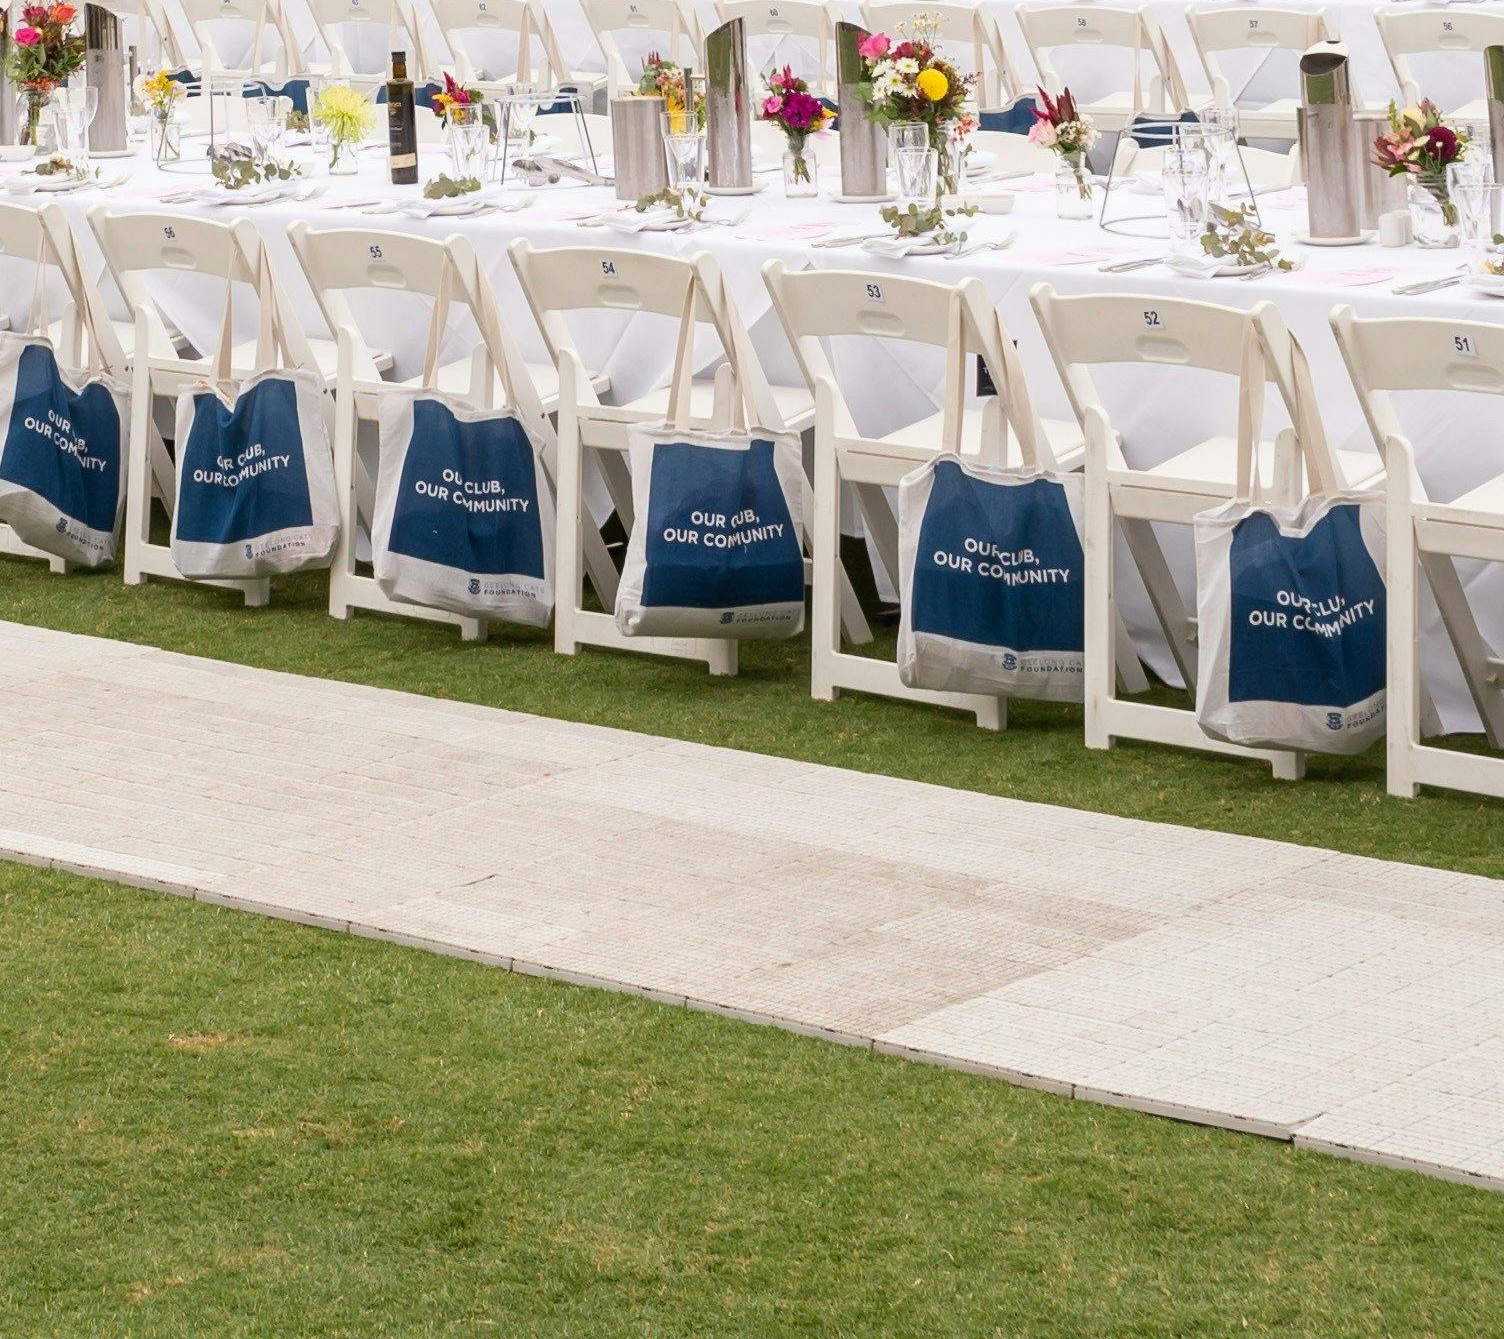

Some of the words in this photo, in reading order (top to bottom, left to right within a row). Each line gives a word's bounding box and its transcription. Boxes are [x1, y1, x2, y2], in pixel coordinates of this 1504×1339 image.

[370, 246, 382, 258] 55
[602, 262, 615, 274] 54
[867, 284, 881, 298] 53
[1144, 311, 1160, 326] 52
[1455, 337, 1469, 352] 51
[48, 409, 72, 432] OUR
[24, 417, 52, 439] OUR
[54, 432, 107, 472] COMNITY
[237, 443, 266, 467] CUB,
[193, 469, 223, 484] OUR
[442, 469, 462, 486] OU
[464, 480, 505, 496] CLUB,
[415, 480, 449, 501] OUR
[453, 490, 530, 513] CMMUNITY
[691, 510, 726, 528] OUR
[663, 528, 699, 545] OUR
[703, 524, 784, 549] COMUNITY
[933, 551, 972, 574] OUR
[1000, 548, 1040, 566] CLUB,
[1248, 610, 1288, 629] OUR
[1292, 599, 1375, 639] COMMNITY
[1020, 665, 1084, 674] FOUNDATION
